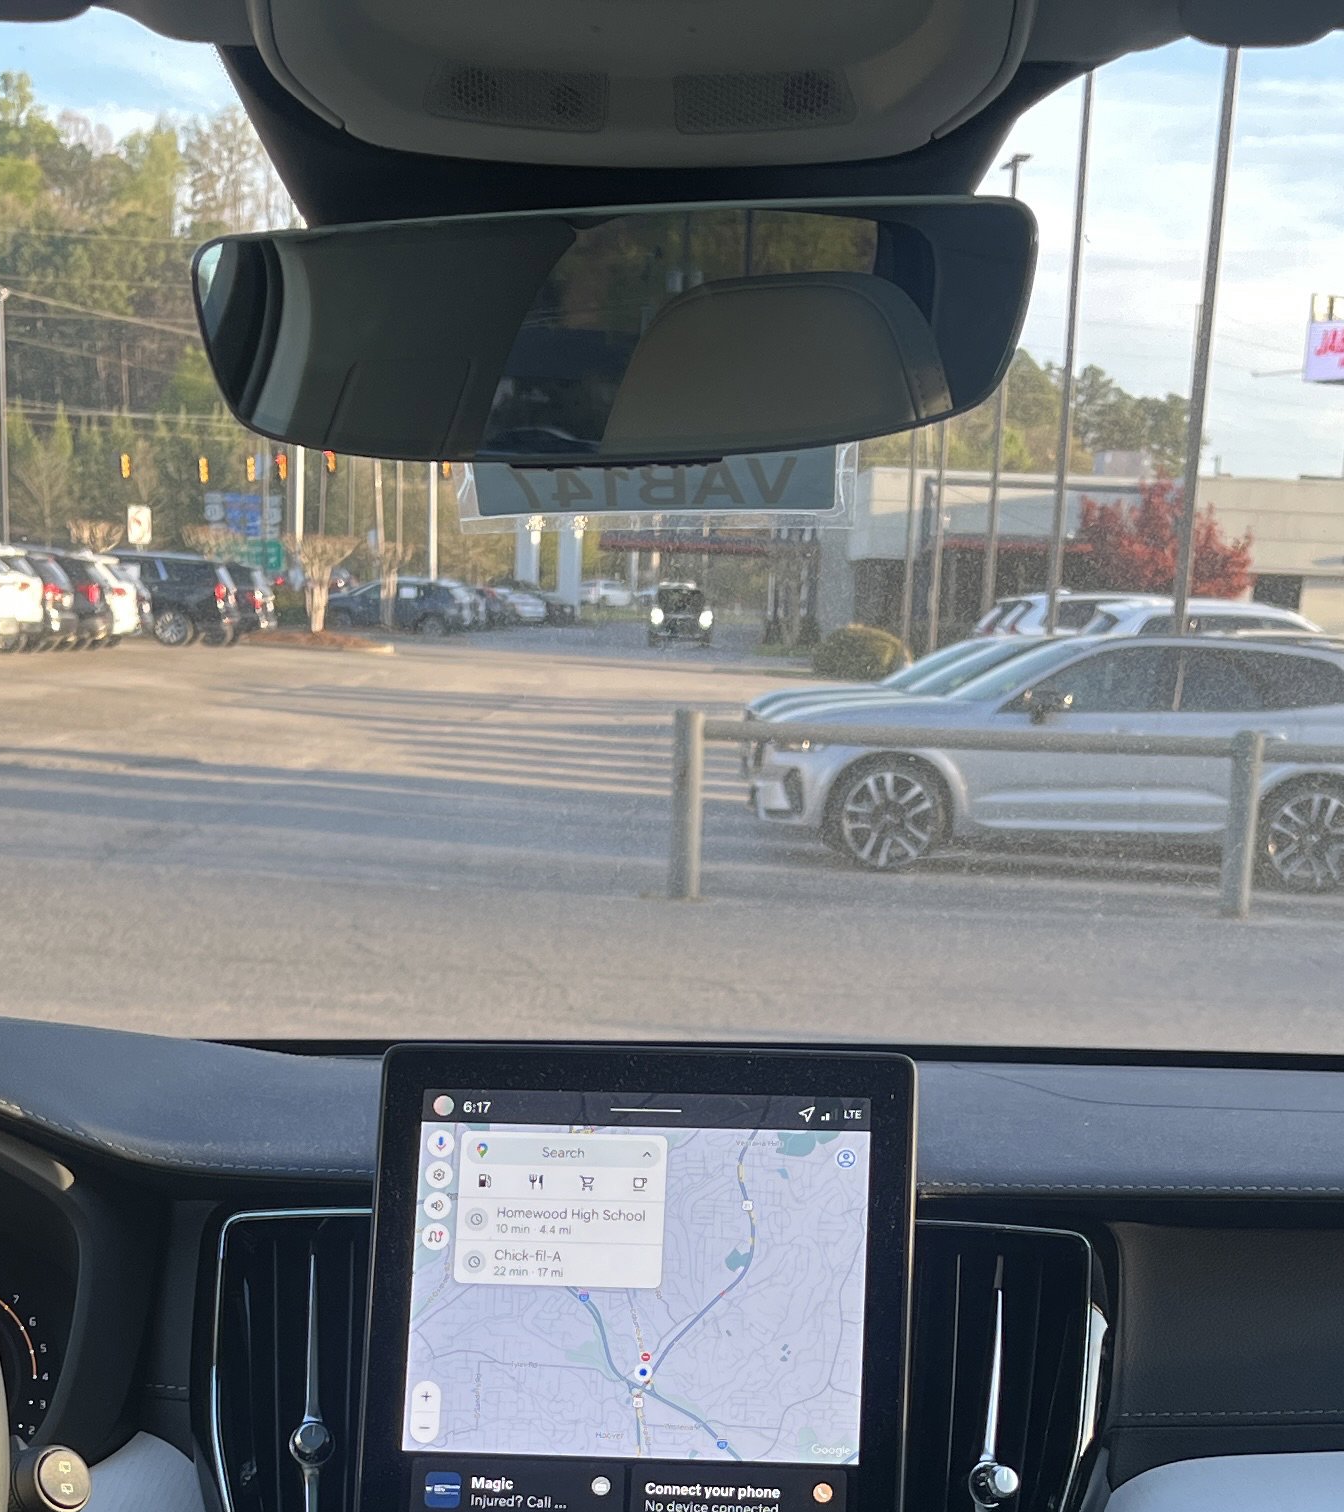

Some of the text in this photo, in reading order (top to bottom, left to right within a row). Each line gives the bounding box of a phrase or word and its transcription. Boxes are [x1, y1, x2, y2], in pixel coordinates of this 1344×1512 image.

[462, 1101, 492, 1114] 6:17
[843, 1109, 863, 1120] LTE
[541, 1147, 585, 1159] Search
[496, 1207, 646, 1224] Homewood High School
[496, 1224, 508, 1234] 10
[511, 1224, 530, 1234] min
[559, 1225, 572, 1235] mi
[494, 1249, 561, 1263] Chick-fil-A
[493, 1265, 564, 1277] 22 min 17 mi
[811, 1444, 851, 1458] Google
[471, 1476, 514, 1492] Magic
[645, 1482, 781, 1500] Connect your phone
[470, 1494, 523, 1509] Injured?
[526, 1496, 551, 1509] Call
[645, 1500, 664, 1512] No
